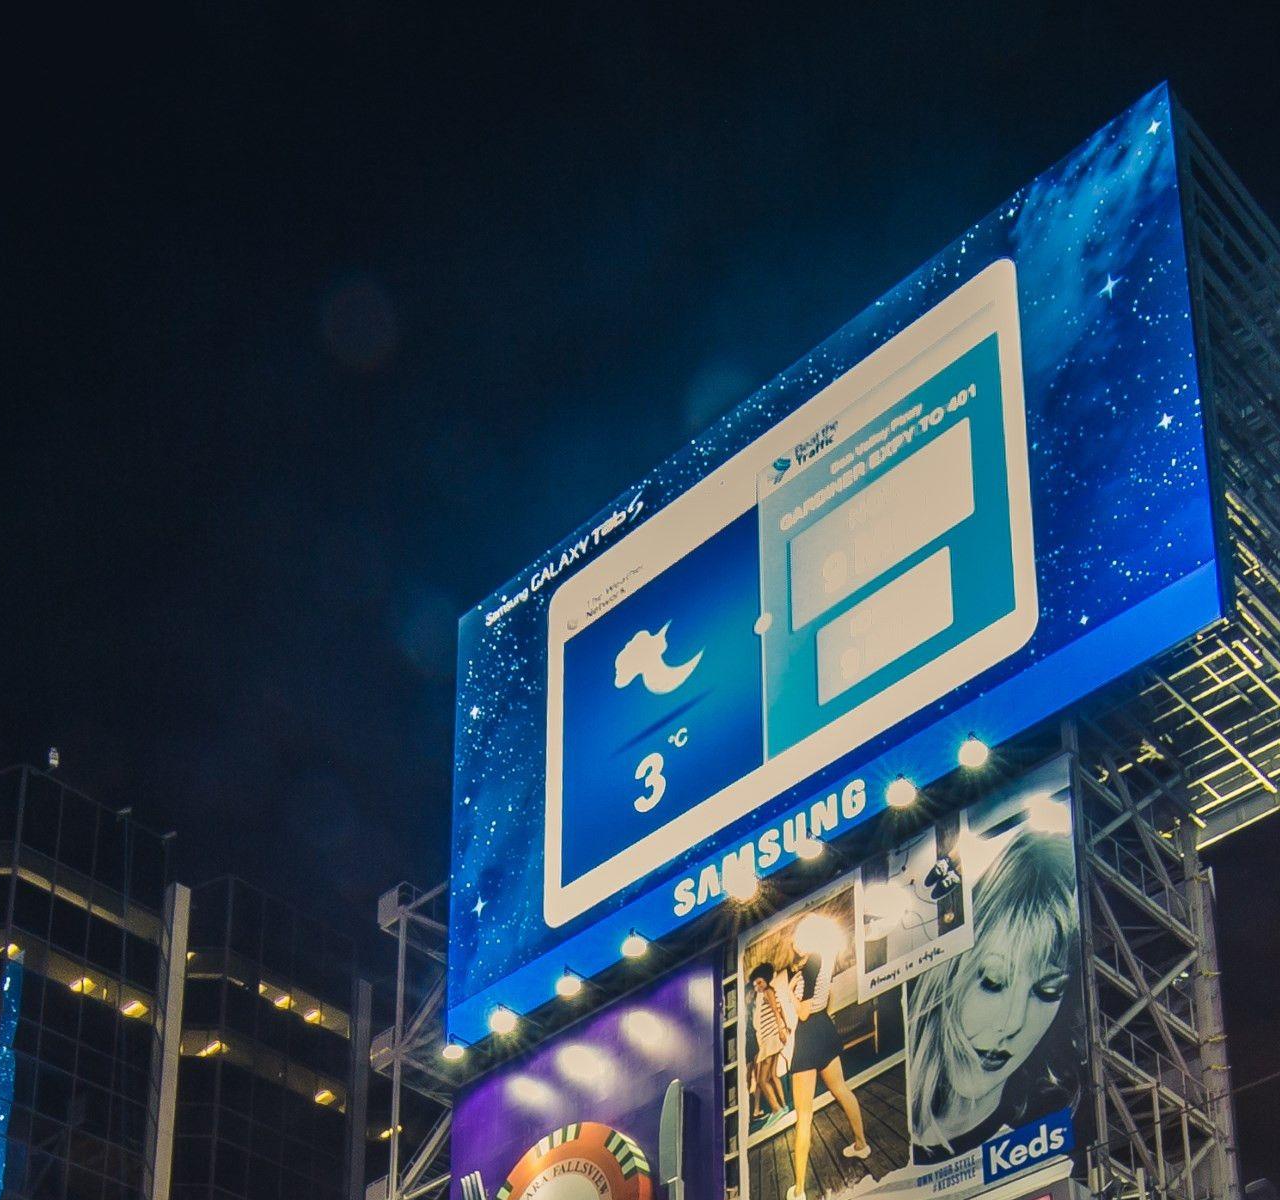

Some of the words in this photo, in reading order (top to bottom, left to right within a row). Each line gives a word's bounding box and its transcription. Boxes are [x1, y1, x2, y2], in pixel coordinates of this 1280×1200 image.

[918, 406, 945, 433] TO
[947, 383, 977, 412] 401
[485, 587, 529, 627] Samsung
[531, 535, 589, 591] GALAXY
[634, 752, 666, 813] 3
[674, 778, 867, 917] SAMSUNG
[870, 967, 901, 989] Always
[934, 1165, 955, 1182] YOUR
[954, 1154, 976, 1173] STYLE
[990, 1123, 1065, 1176] Keds
[552, 1160, 609, 1195] FALLSVIEW
